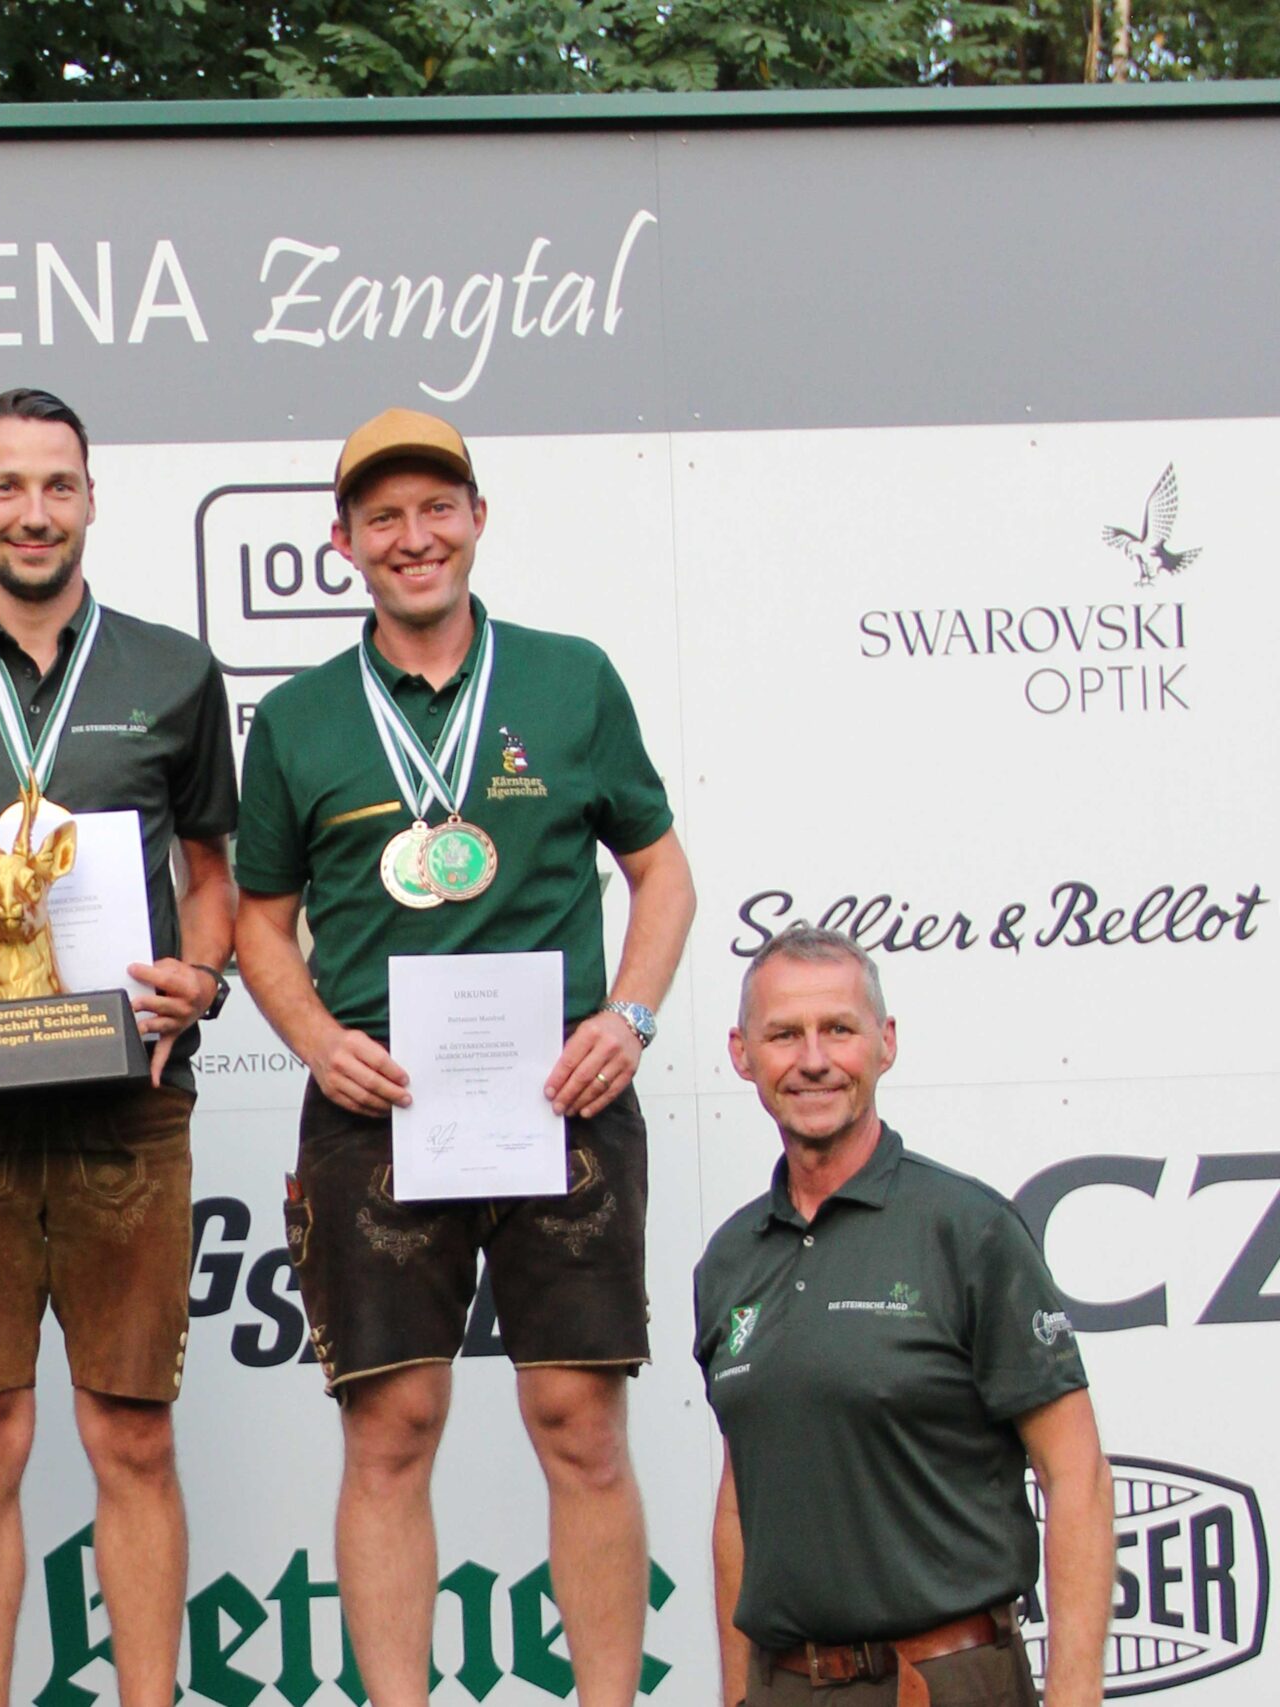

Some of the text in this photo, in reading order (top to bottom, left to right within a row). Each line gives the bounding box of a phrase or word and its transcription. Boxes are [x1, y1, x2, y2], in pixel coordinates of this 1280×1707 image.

[251, 208, 659, 402] Zangtal
[859, 602, 1186, 659] SWAROVSKI
[1024, 663, 1190, 715] OPTIK
[491, 776, 543, 787] Kärntner
[486, 784, 549, 800] Jägerschaft
[730, 880, 1270, 958] Sllier & Bellot
[454, 989, 499, 999] URKUNDE
[43, 1012, 108, 1029] Schießen
[33, 1025, 116, 1042] Kombination
[1011, 1151, 1280, 1333] CZ
[885, 1301, 909, 1311] JAGD
